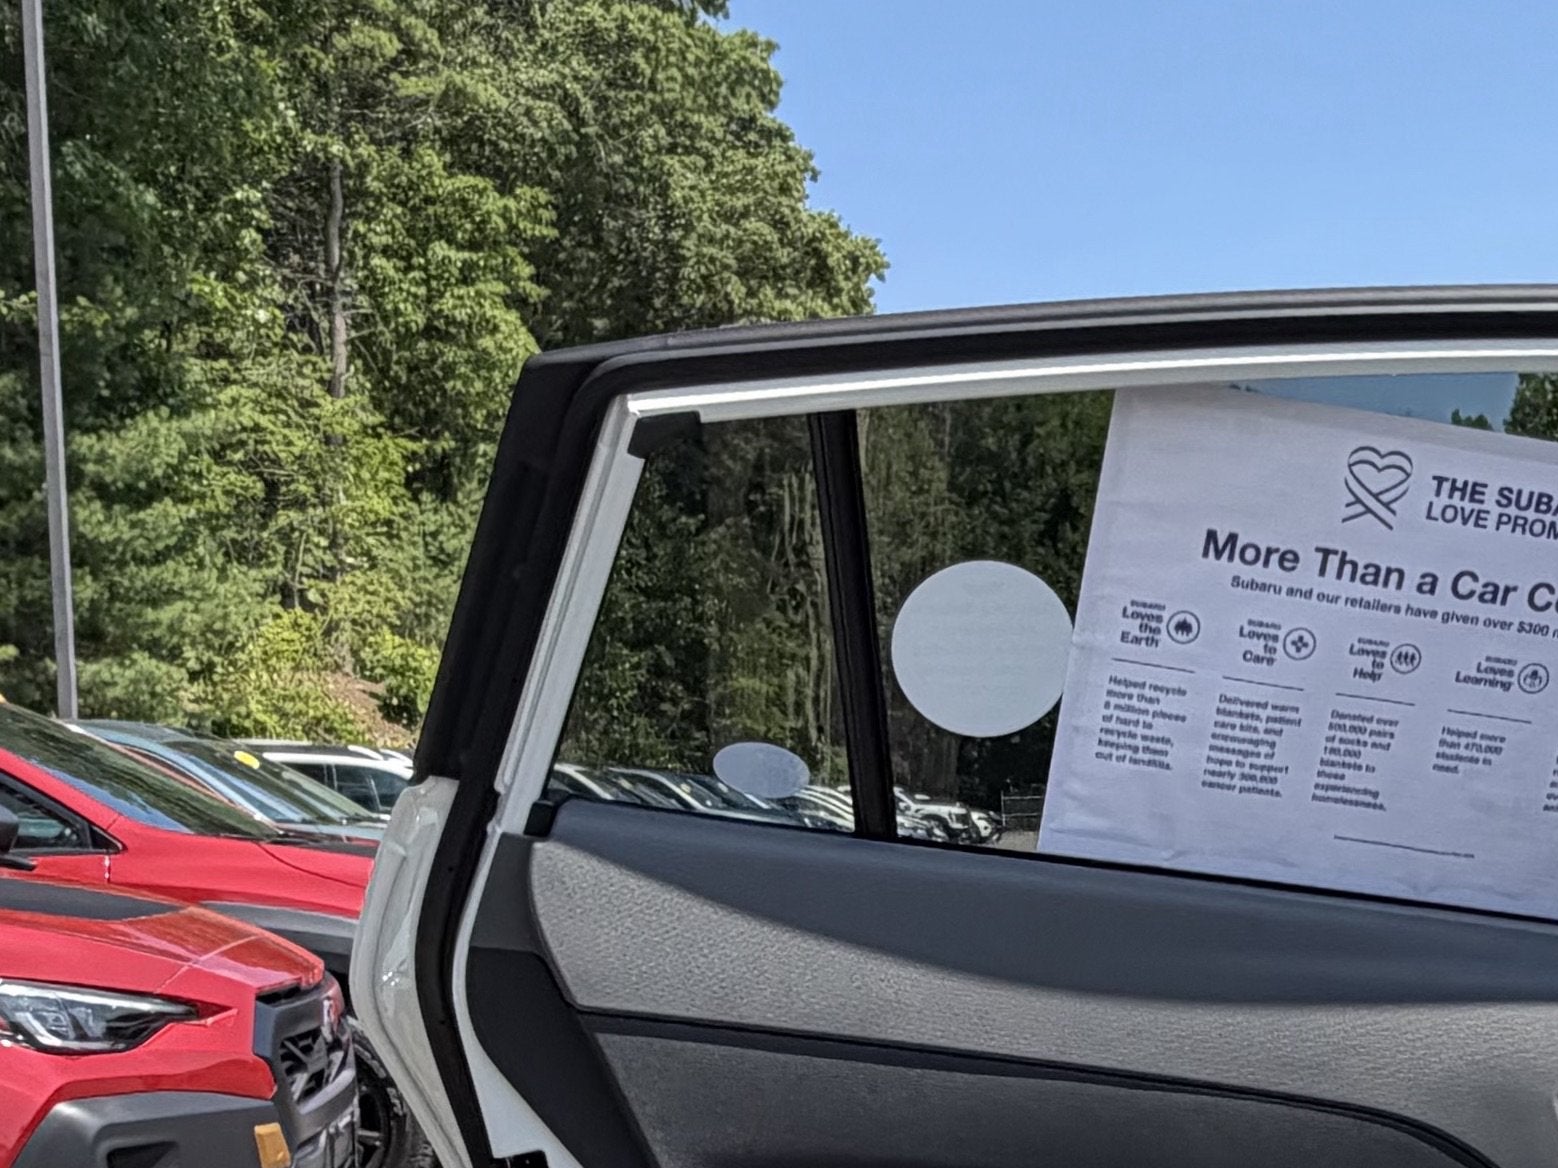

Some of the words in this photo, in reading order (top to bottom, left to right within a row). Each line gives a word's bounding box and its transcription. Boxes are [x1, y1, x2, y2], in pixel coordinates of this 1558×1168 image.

[1432, 475, 1488, 504] THE
[1425, 501, 1490, 529] LOVE
[1202, 528, 1300, 573] More
[1314, 546, 1405, 591] Than
[1416, 571, 1439, 596] a
[1451, 570, 1518, 607] Car
[1230, 574, 1282, 596] Subaru
[1286, 587, 1313, 600] and
[1316, 591, 1341, 605] our
[1344, 594, 1401, 614] retailers
[1405, 604, 1438, 620] have
[1441, 611, 1479, 627] given
[1483, 618, 1514, 632] over
[1516, 620, 1549, 637] $300
[1122, 606, 1163, 624] Loves
[1138, 622, 1161, 635] the
[1239, 625, 1280, 643] Loves
[1120, 631, 1160, 648] Earth
[1263, 643, 1277, 655] to
[1349, 643, 1387, 660] Loves
[1242, 650, 1276, 666] Care
[1371, 658, 1385, 671] to
[1353, 667, 1383, 683] Help
[1476, 661, 1515, 678] Loves
[1108, 675, 1146, 690] Helped
[1455, 670, 1512, 692] Learning
[1137, 692, 1160, 706] than
[1219, 693, 1269, 710] Delivered
